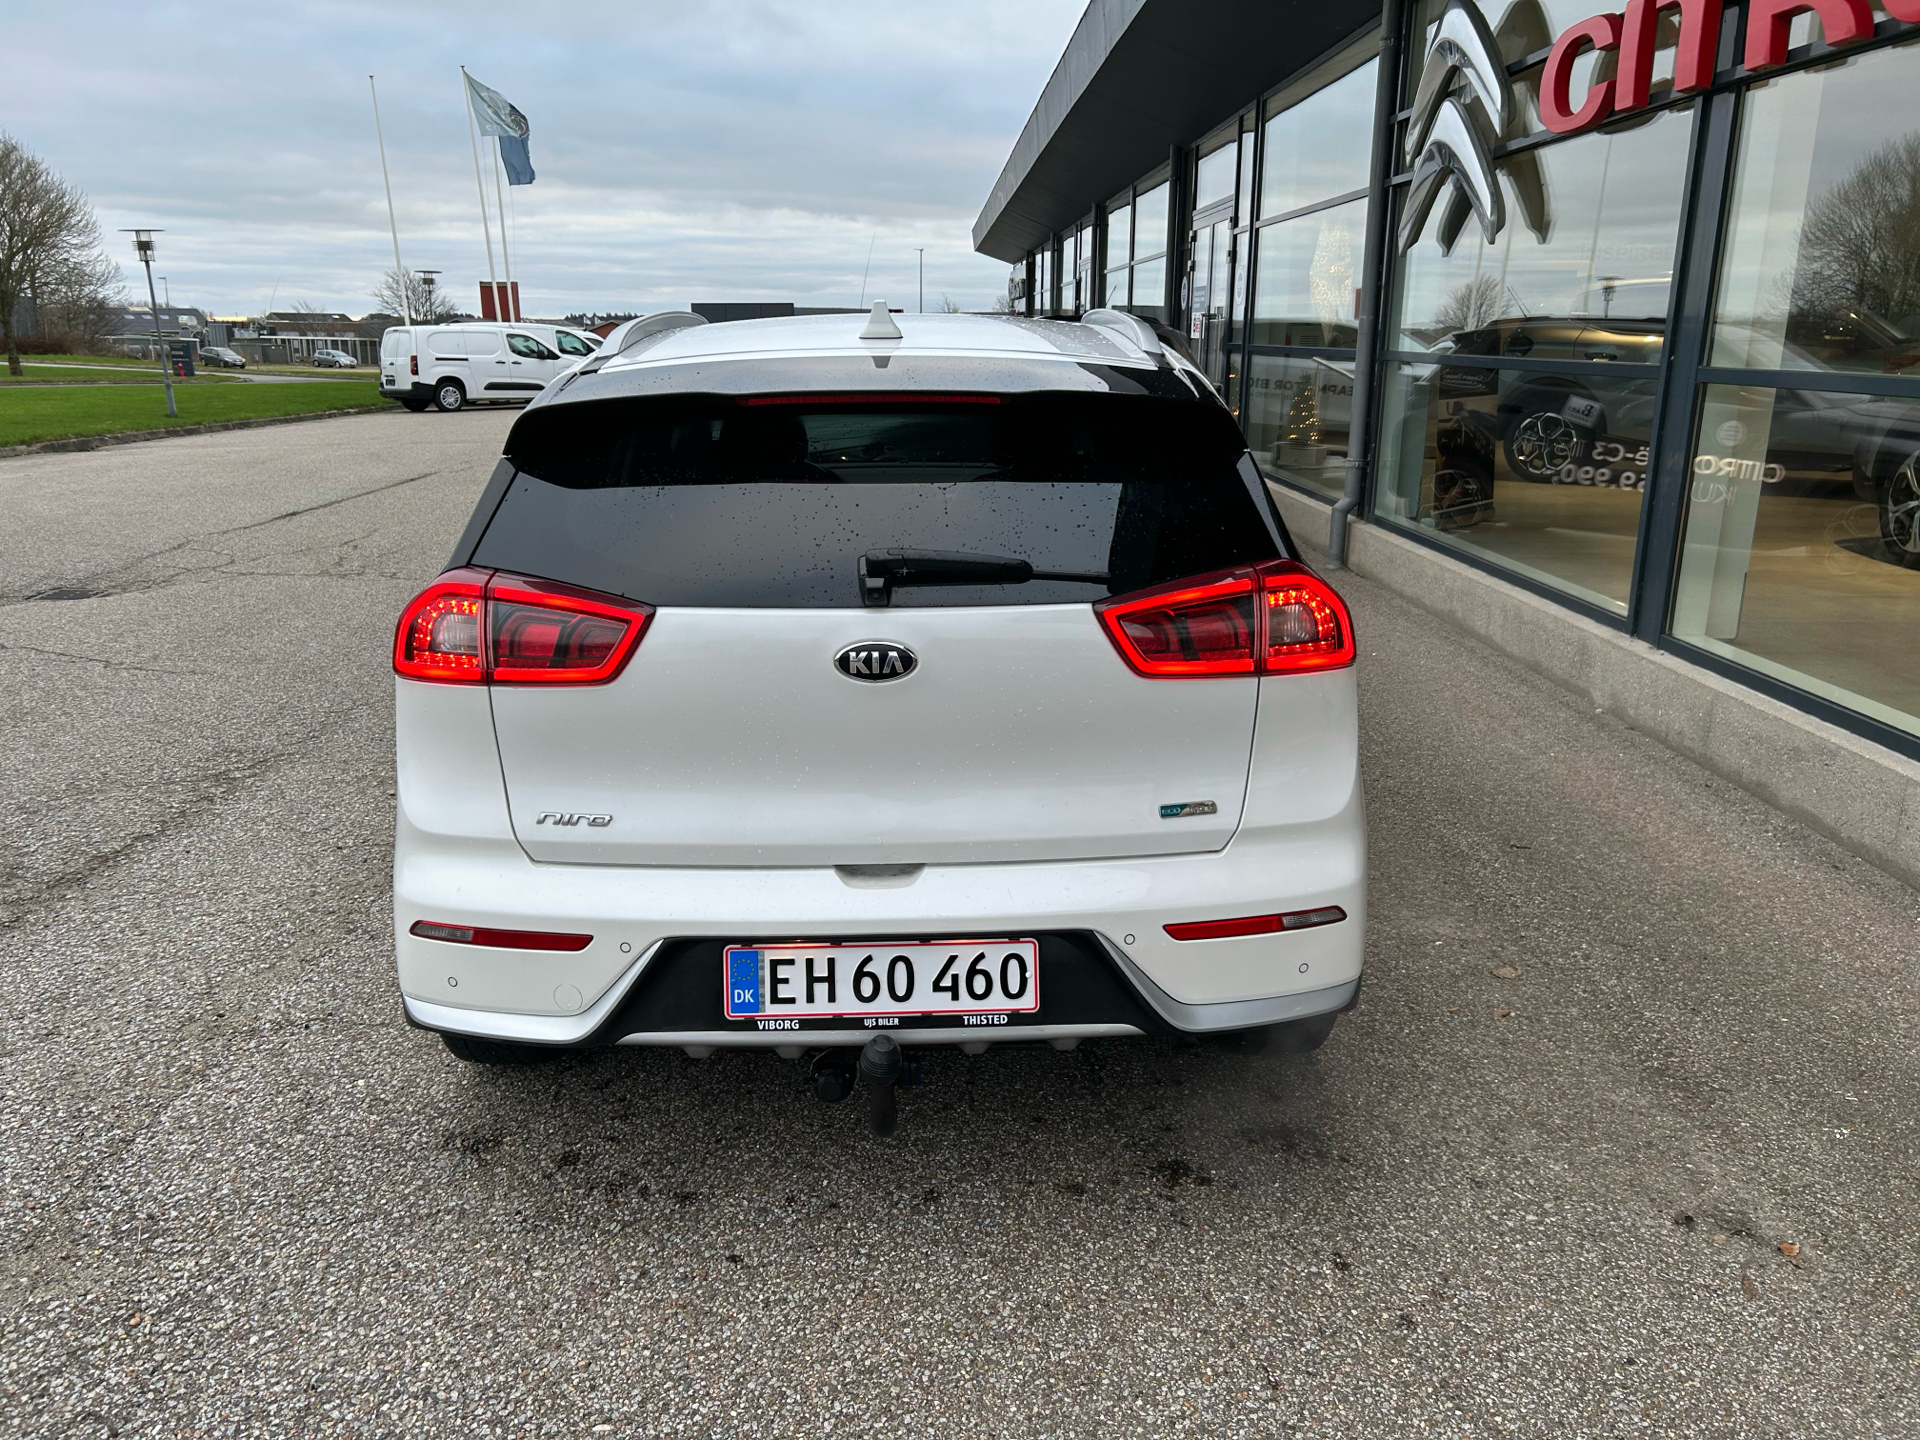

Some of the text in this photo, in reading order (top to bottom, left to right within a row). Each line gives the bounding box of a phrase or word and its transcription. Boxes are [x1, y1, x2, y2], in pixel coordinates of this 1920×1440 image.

[1540, 0, 1920, 134] CITR
[848, 650, 905, 674] KIA
[768, 950, 1029, 1005] EH 60 460
[734, 988, 754, 1004] DK
[757, 1014, 1008, 1031] VIBORG UJS BILER THISTED
